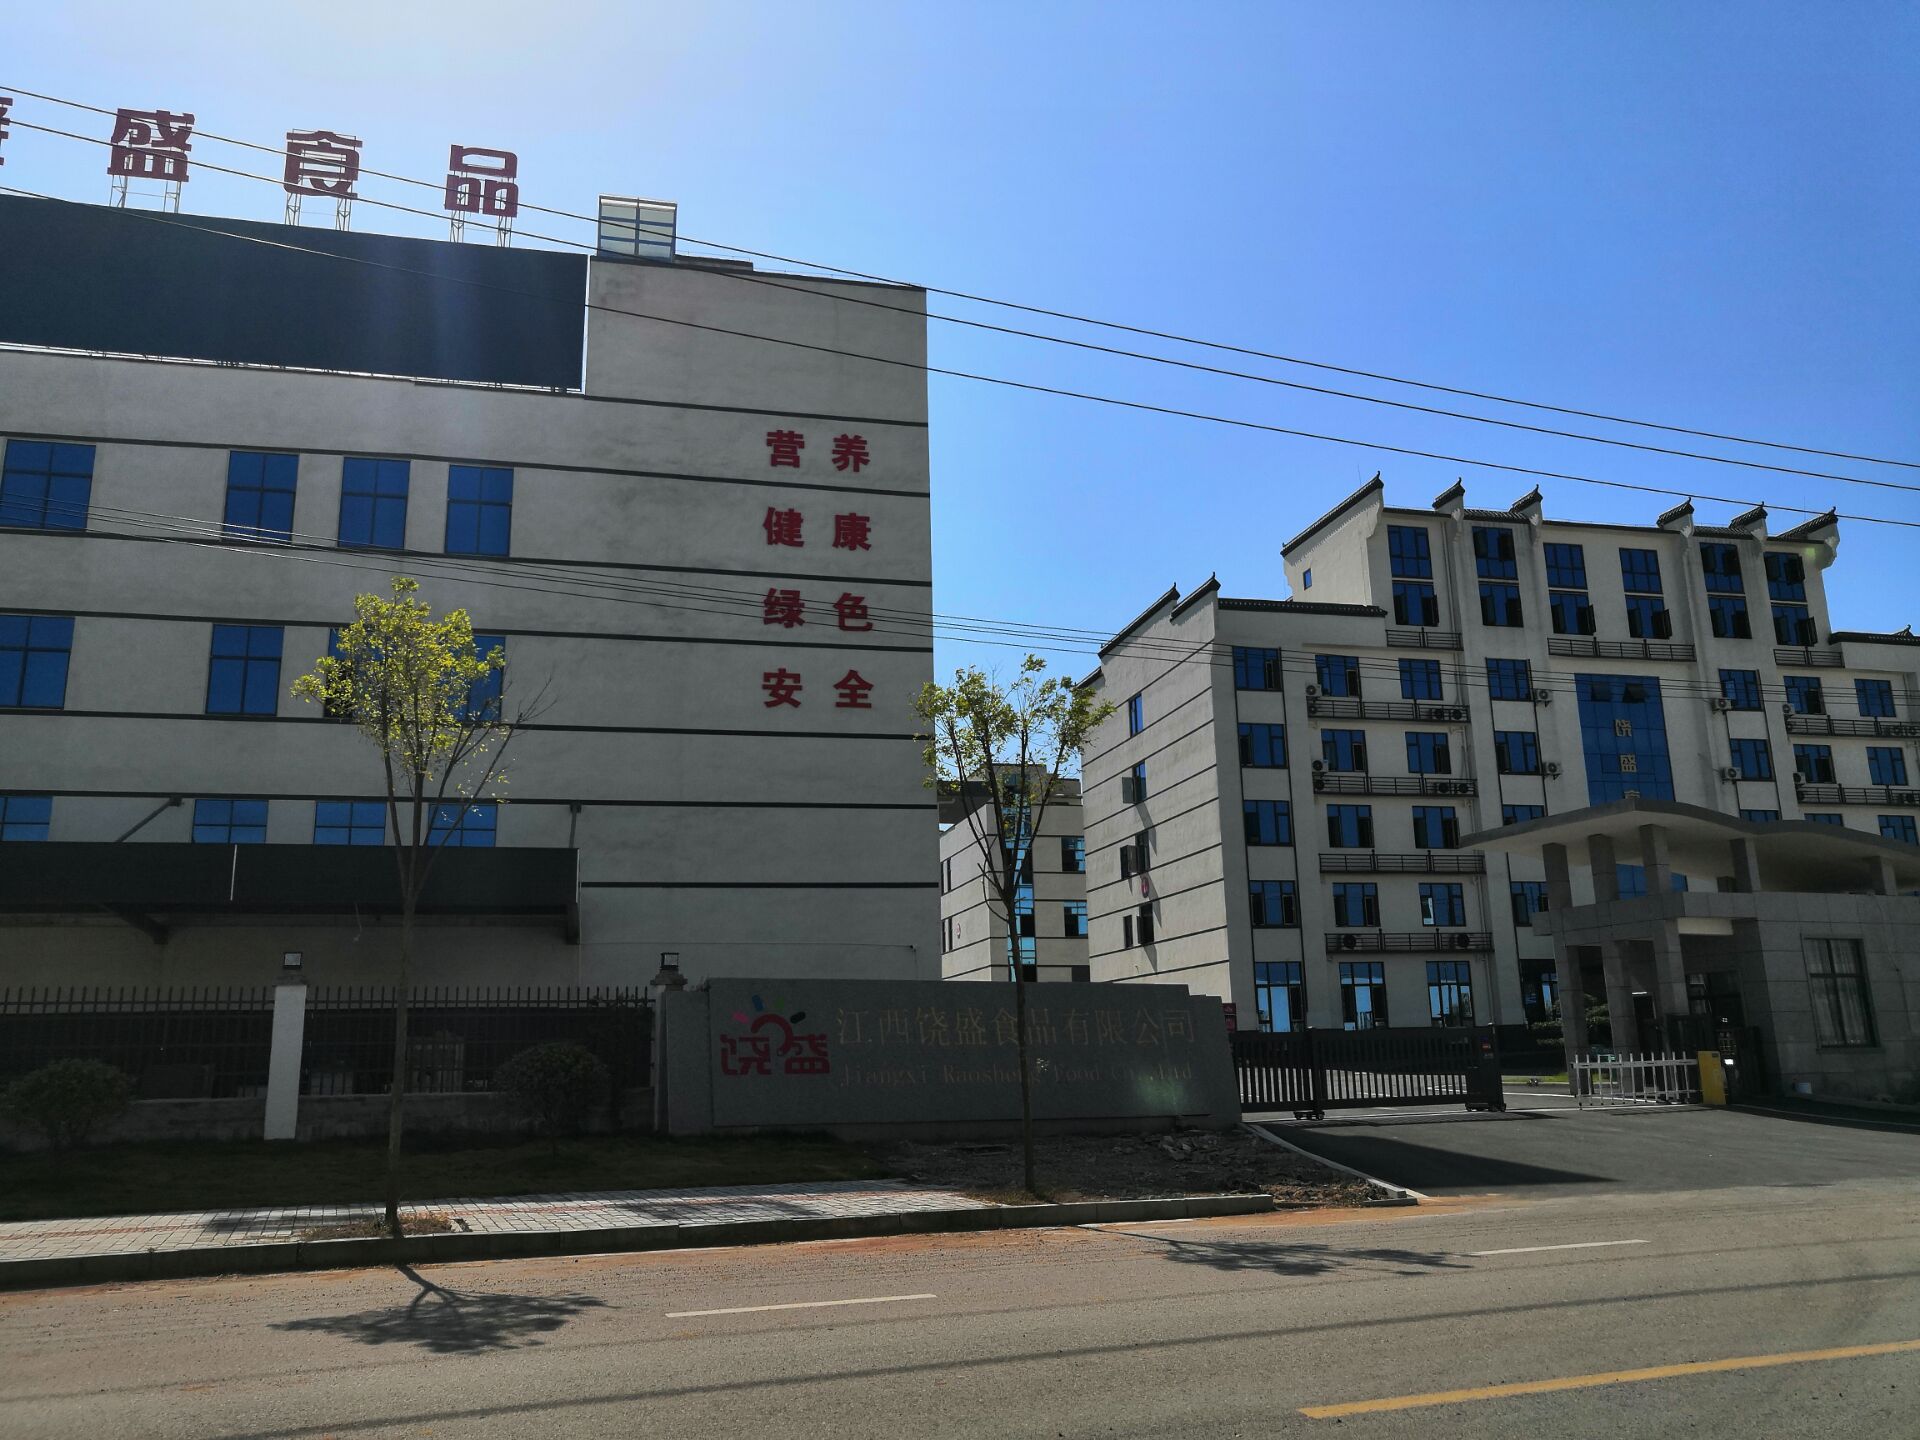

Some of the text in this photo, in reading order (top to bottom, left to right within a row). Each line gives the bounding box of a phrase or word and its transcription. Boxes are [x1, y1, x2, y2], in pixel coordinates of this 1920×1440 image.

[0, 97, 518, 218] 盛食品
[766, 430, 870, 472] 营养
[763, 507, 871, 551] 健康
[763, 588, 873, 632] 绿色
[762, 668, 874, 709] 安全
[837, 1006, 1195, 1047] 江西饶盛食品有限公司
[943, 1063, 1041, 1087] Raosheg
